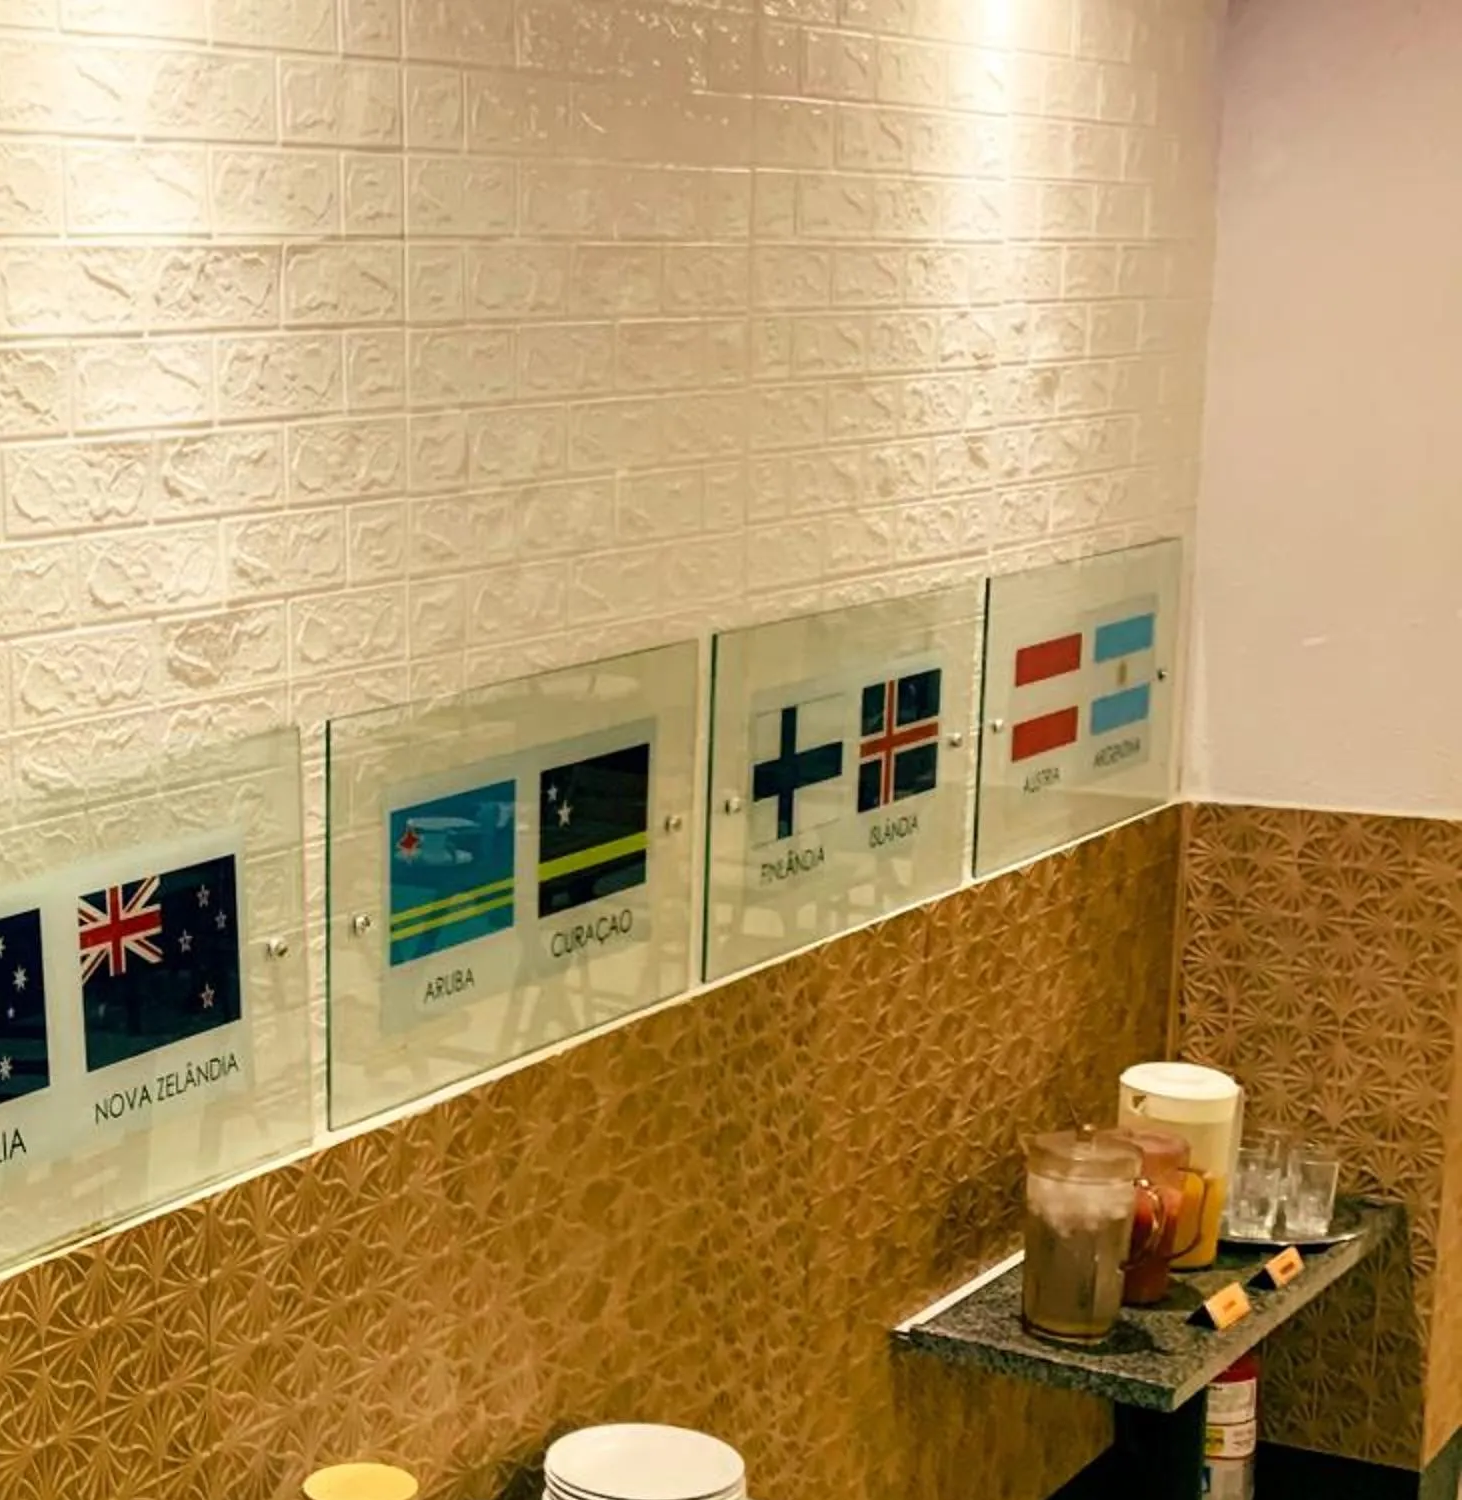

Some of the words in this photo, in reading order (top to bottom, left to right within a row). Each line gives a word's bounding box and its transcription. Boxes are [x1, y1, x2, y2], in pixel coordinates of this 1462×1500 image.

[550, 909, 634, 958] CURAÇAO
[423, 967, 475, 1004] ARUBA
[93, 1084, 152, 1125] NOVA
[156, 1052, 240, 1102] ZELÂNDIA
